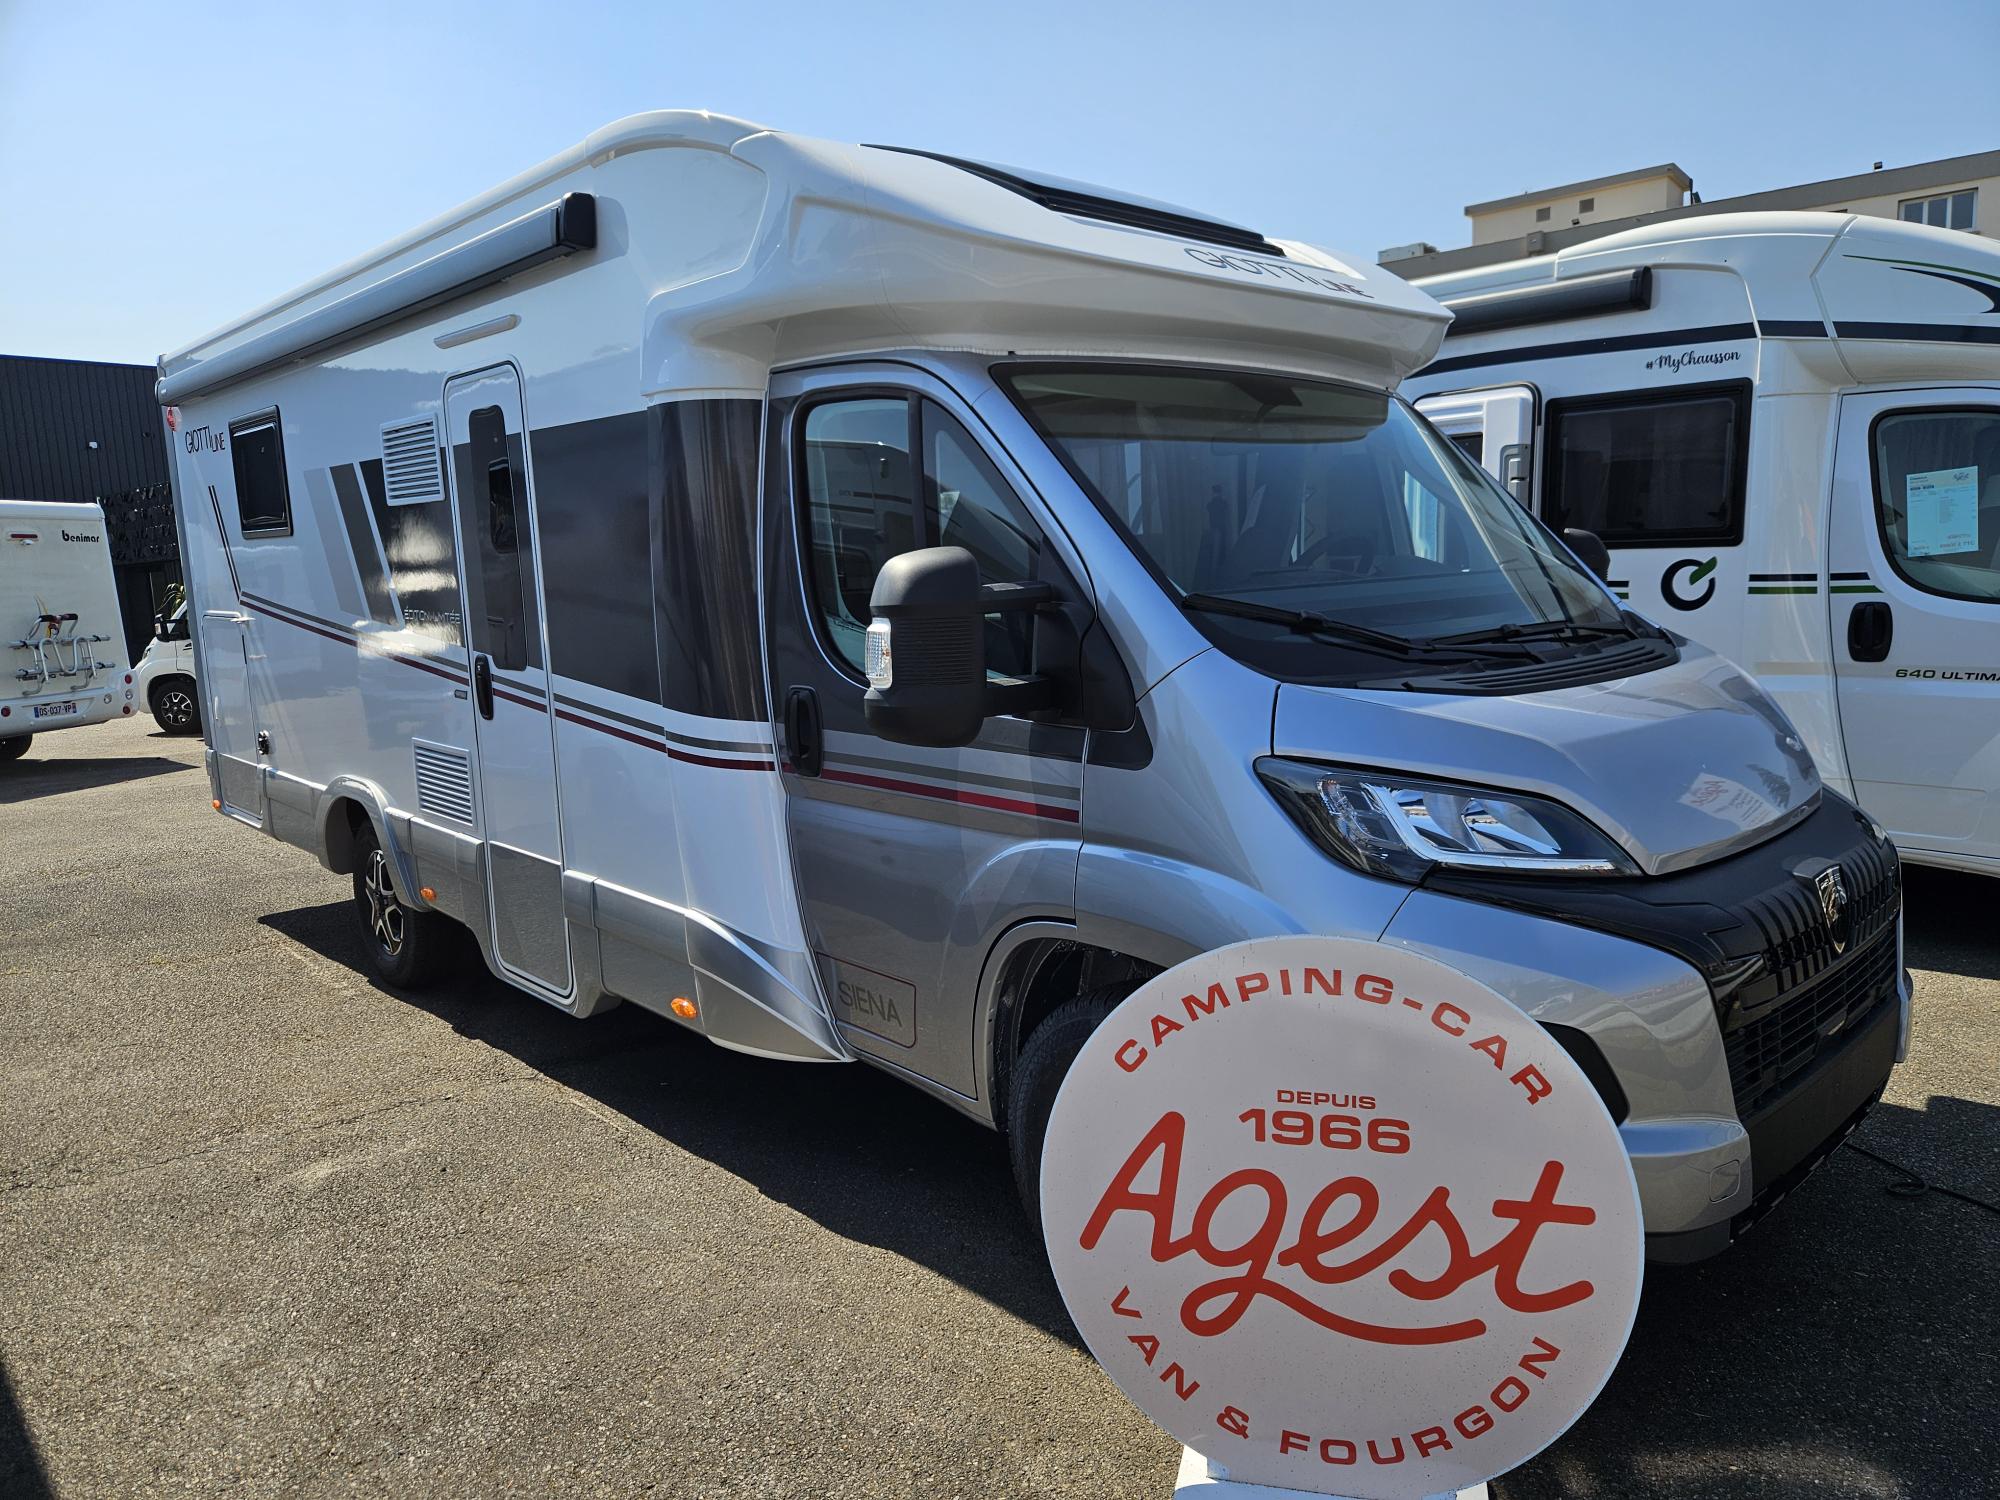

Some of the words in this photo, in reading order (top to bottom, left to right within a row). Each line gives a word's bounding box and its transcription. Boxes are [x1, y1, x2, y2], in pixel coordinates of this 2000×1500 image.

[1646, 350, 1741, 374] #MyChausson
[61, 529, 100, 543] benimar
[1895, 669, 1936, 679] 640
[1941, 671, 2000, 682] ULTIM
[838, 980, 902, 1028] SIENA
[1114, 967, 1553, 1106] CAMPING-CAR
[1276, 1088, 1377, 1110] DEPUIS
[1239, 1108, 1411, 1154] 1966
[1079, 1111, 1596, 1345] Agest
[1111, 1285, 1201, 1401] VAN
[1216, 1406, 1250, 1440] &
[1279, 1336, 1562, 1466] FOURGON
